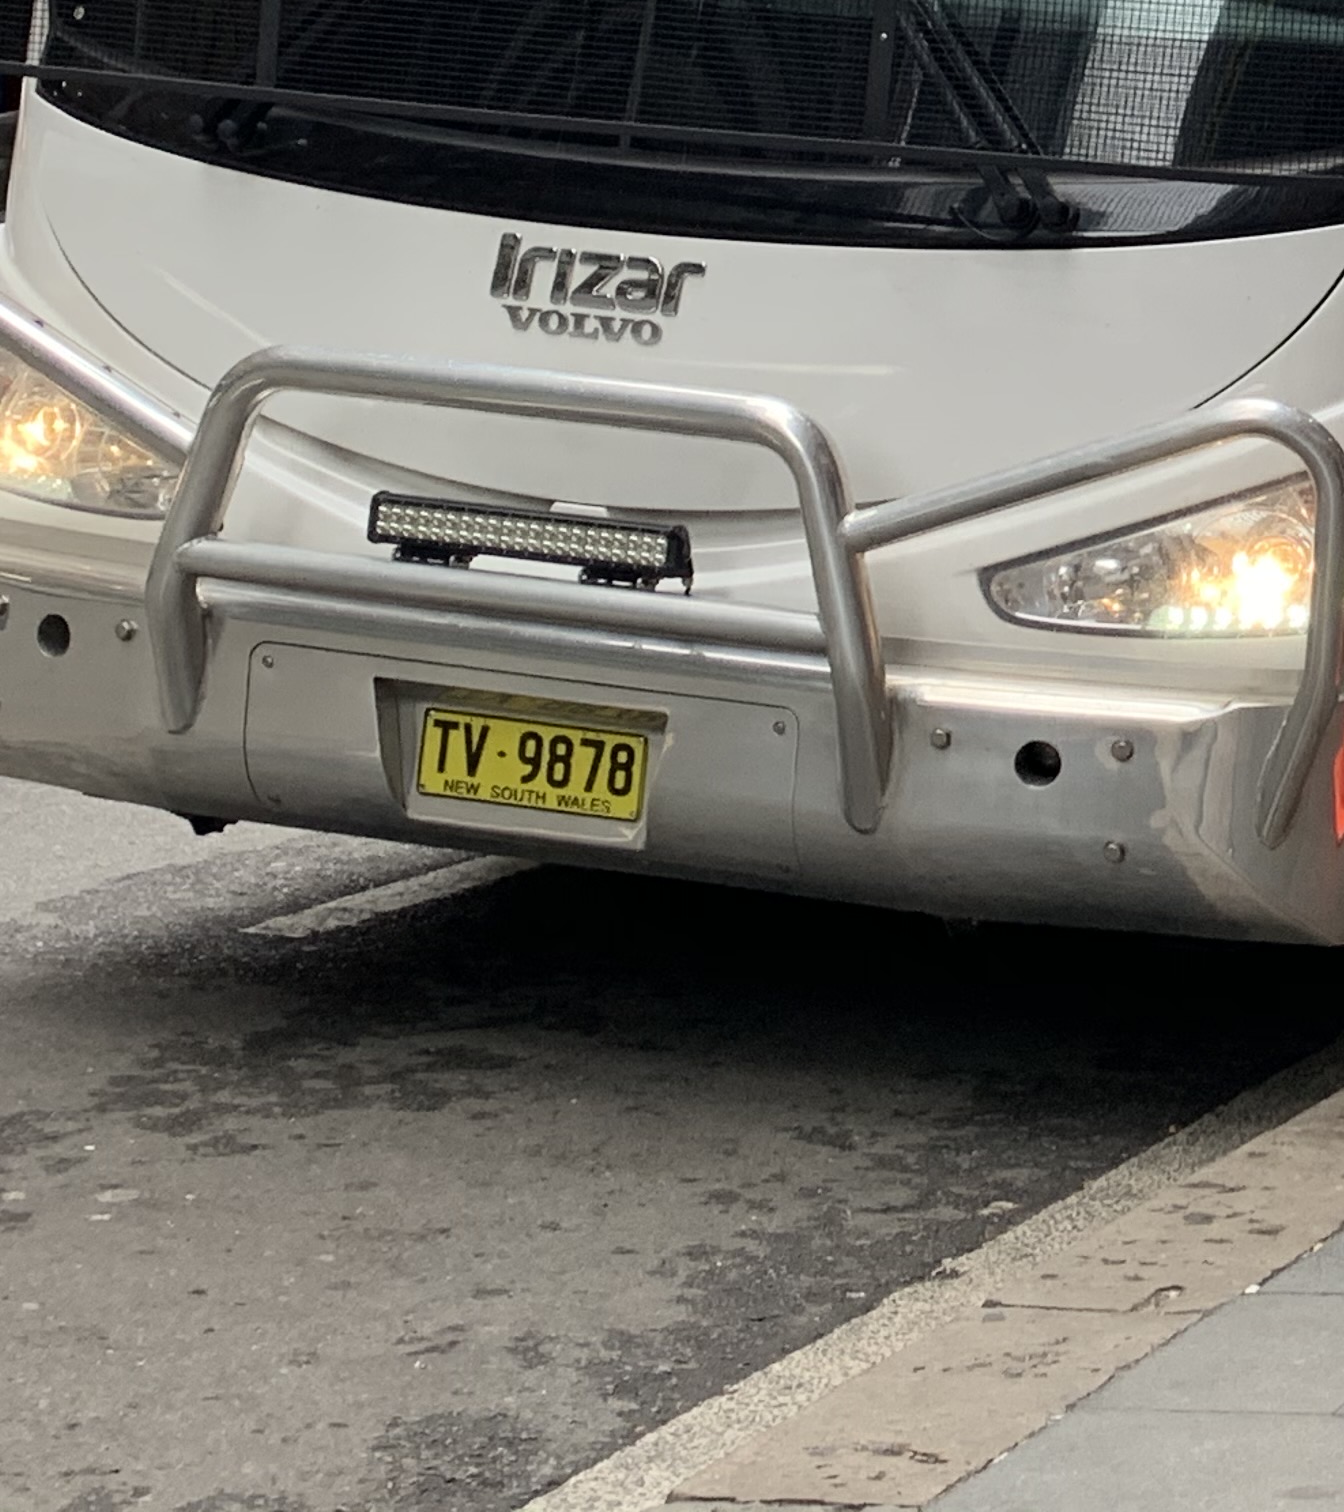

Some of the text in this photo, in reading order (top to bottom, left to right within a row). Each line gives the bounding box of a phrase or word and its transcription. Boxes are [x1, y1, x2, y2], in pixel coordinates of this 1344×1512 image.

[501, 304, 663, 346] VOLVO
[444, 779, 612, 815] NEW SOUTH WALES
